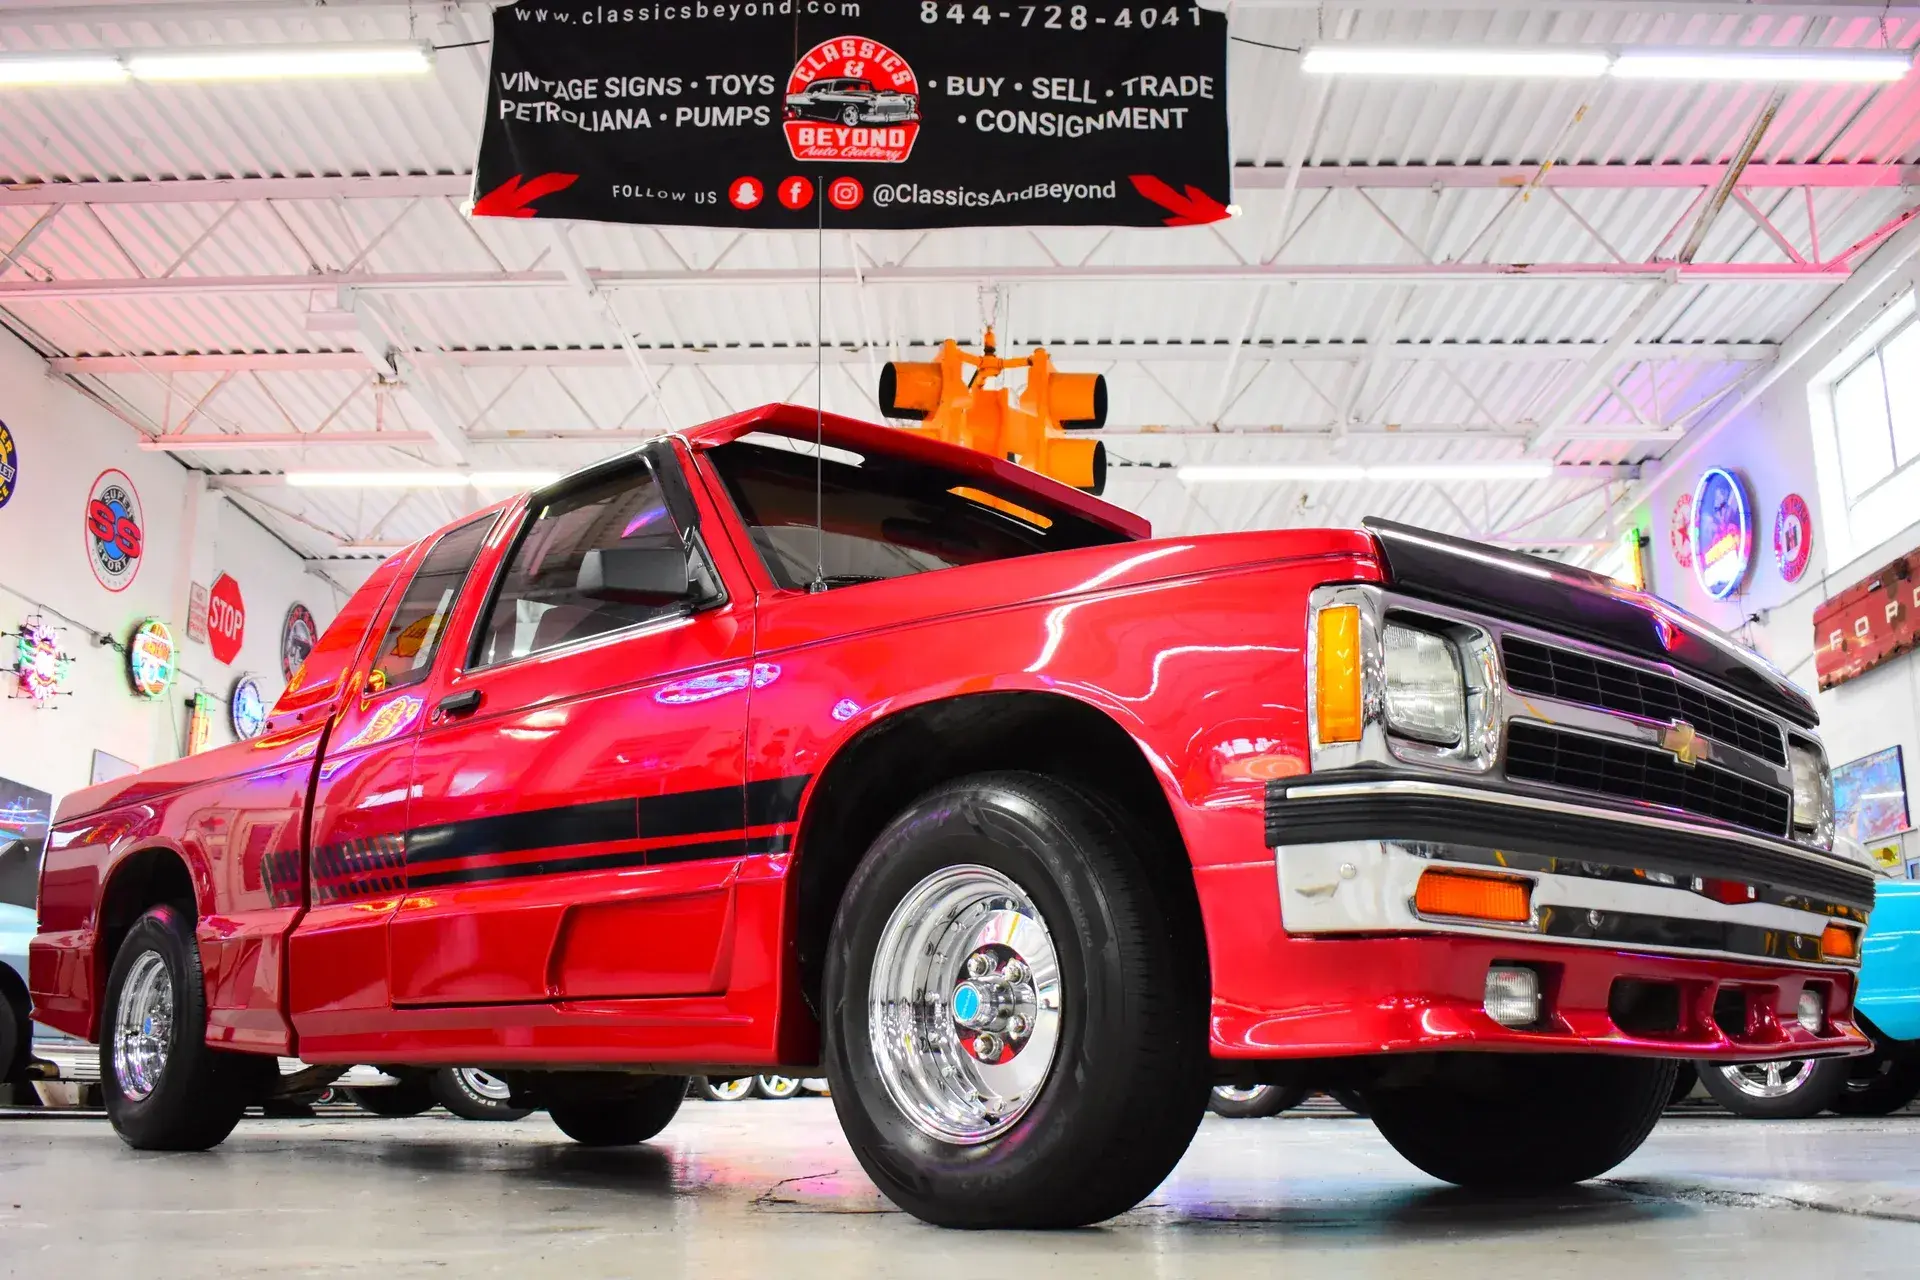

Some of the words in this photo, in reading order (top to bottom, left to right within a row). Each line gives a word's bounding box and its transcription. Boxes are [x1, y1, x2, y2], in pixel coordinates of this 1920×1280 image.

[515, 1, 860, 25] www.classicsbeyond.com
[920, 1, 1200, 30] 844-728-4041
[795, 39, 912, 86] CLASSICS
[843, 60, 864, 78] &
[500, 71, 598, 101] VINTAGE
[604, 77, 683, 98] SIGNS
[705, 75, 775, 96] TOYS
[946, 76, 1005, 97] BUY
[1031, 77, 1097, 104] SELL
[1121, 75, 1214, 99] TRADE
[500, 100, 651, 132] PETROLIANA
[676, 106, 771, 128] PUMPS
[975, 107, 1188, 137] CONSIGNMENT
[798, 127, 906, 148] BEYOND
[800, 145, 838, 157] Auto
[841, 145, 902, 161] Gallery
[694, 191, 717, 204] US
[873, 180, 1116, 208] @ClassicsAndBeyond
[210, 595, 243, 641] STOP
